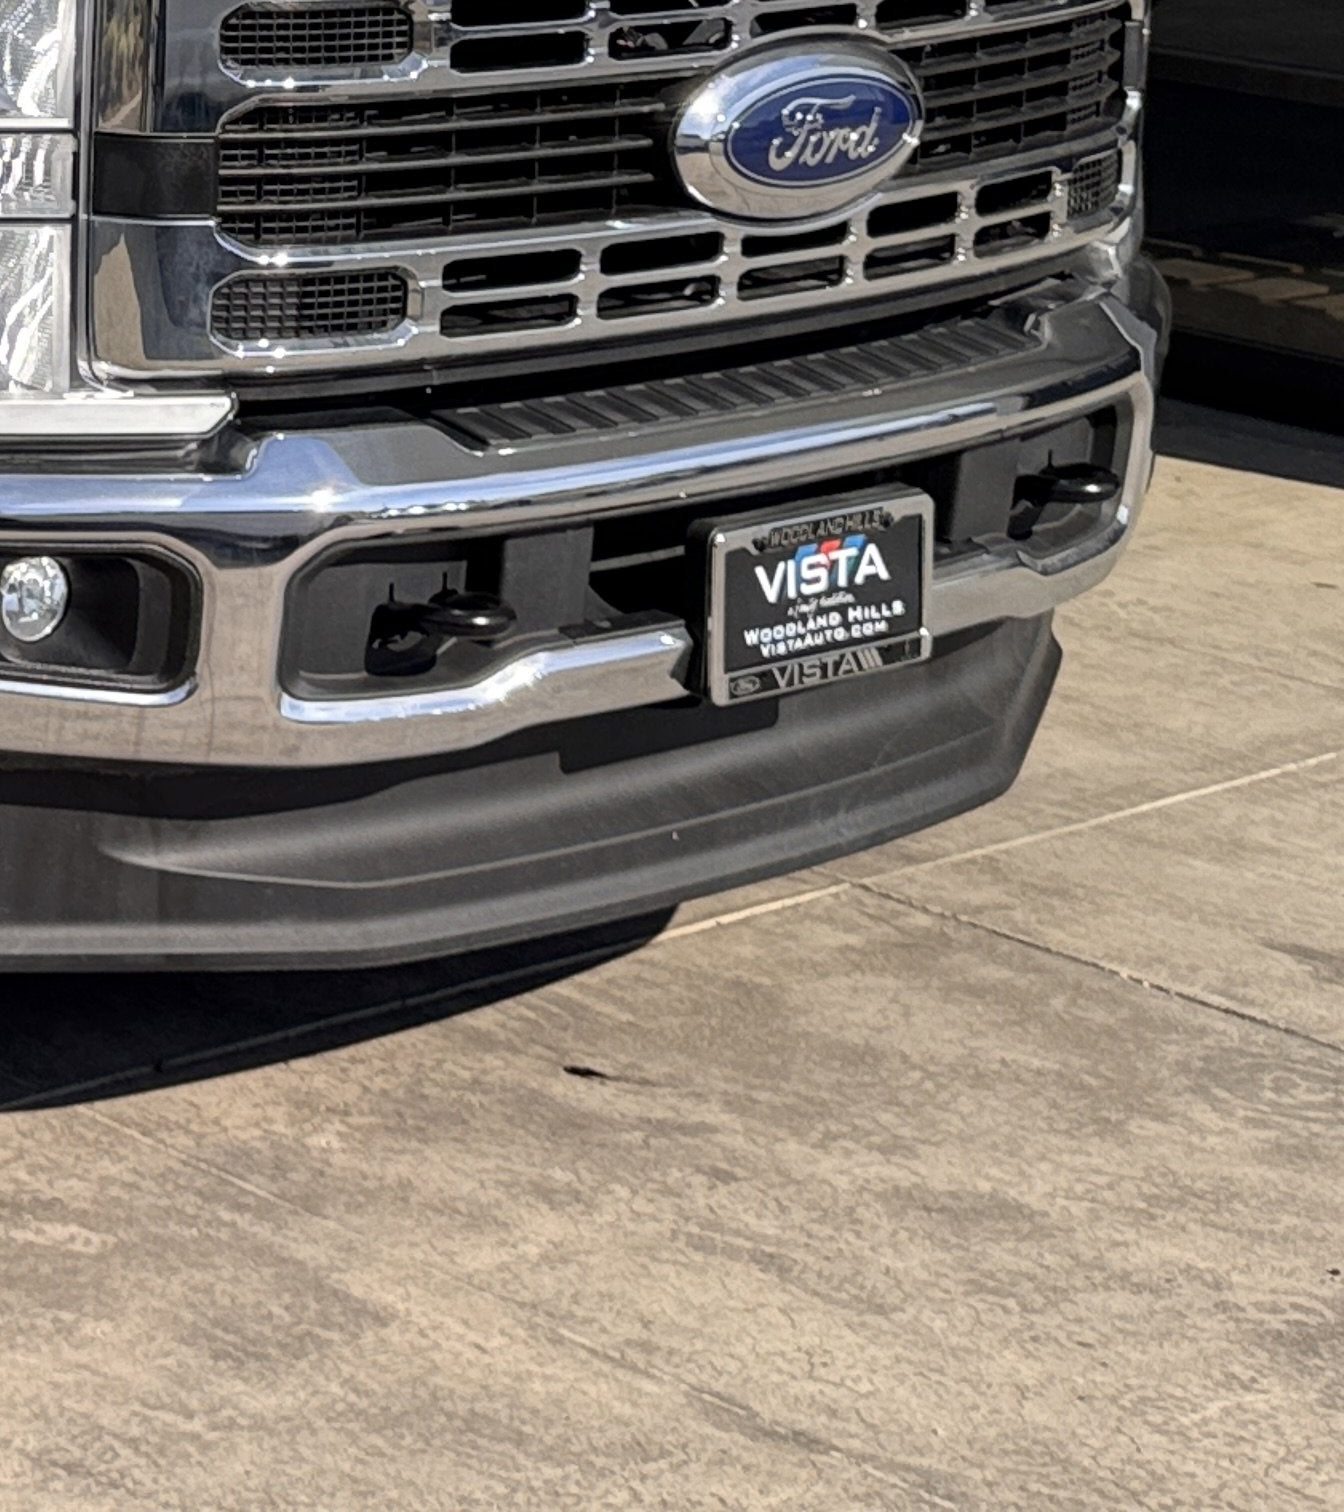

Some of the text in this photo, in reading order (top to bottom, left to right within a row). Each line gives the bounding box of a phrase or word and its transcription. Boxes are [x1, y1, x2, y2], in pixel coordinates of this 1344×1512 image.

[768, 94, 883, 171] Ford
[754, 541, 892, 605] VISTA
[771, 653, 860, 690] VISTA
